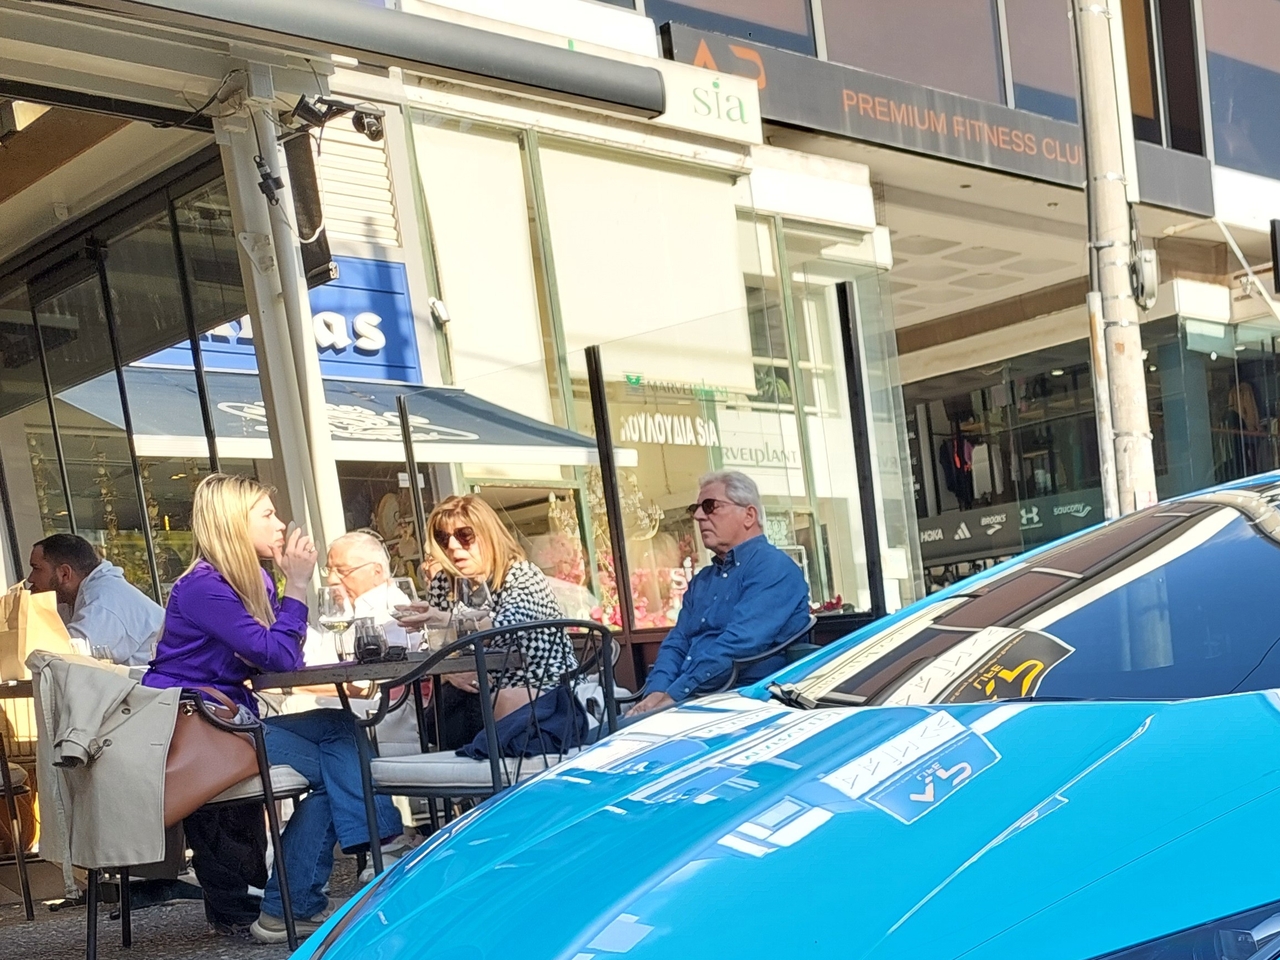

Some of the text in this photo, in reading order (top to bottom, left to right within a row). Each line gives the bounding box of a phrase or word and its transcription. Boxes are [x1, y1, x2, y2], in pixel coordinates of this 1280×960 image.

[842, 89, 1084, 166] PREMIUM FITNESS CLU
[1053, 503, 1084, 516] saucony
[980, 513, 1007, 526] BROOKS
[920, 527, 944, 543] HOKA
[669, 556, 693, 591] si
